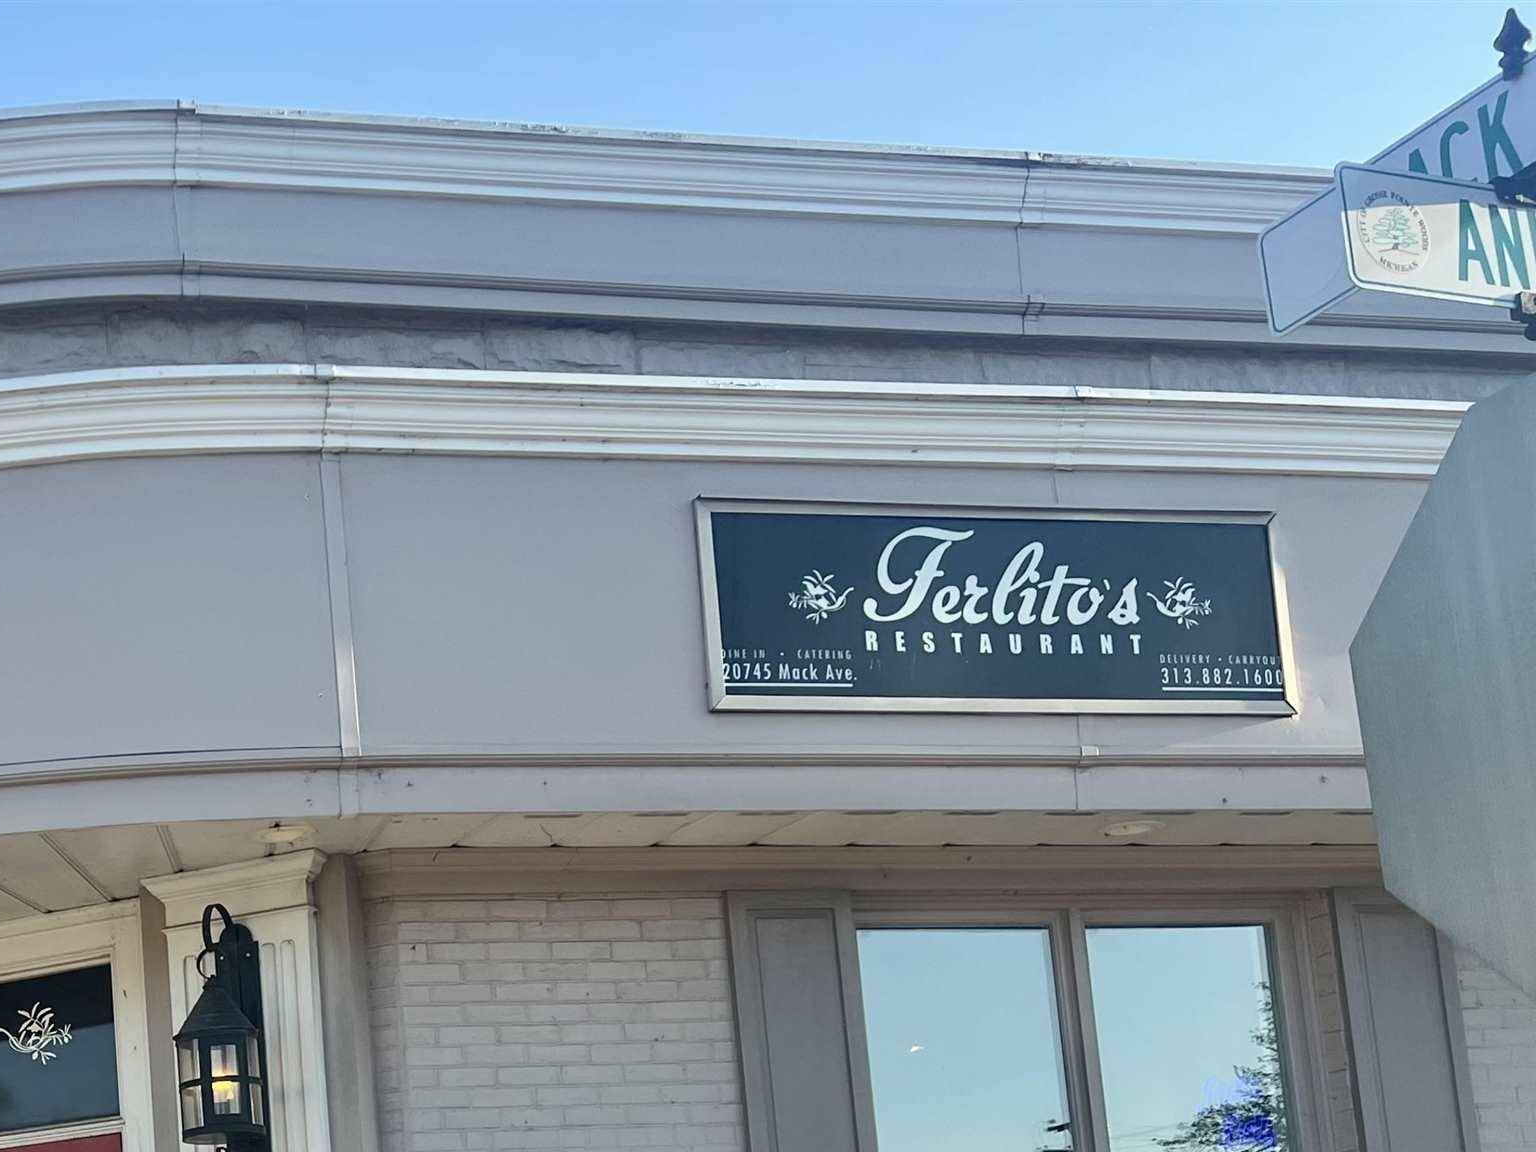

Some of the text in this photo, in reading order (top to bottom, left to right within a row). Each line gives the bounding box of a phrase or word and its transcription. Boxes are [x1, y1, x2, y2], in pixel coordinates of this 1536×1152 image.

[864, 526, 1140, 626] Ferlito's
[865, 629, 1144, 655] RESTAURANT
[753, 649, 766, 659] IN
[797, 649, 853, 660] CATERING
[1159, 653, 1211, 664] DELIVERY
[722, 662, 858, 681] 20745 Mack Ave.
[1160, 667, 1283, 685] 313.882.1600
